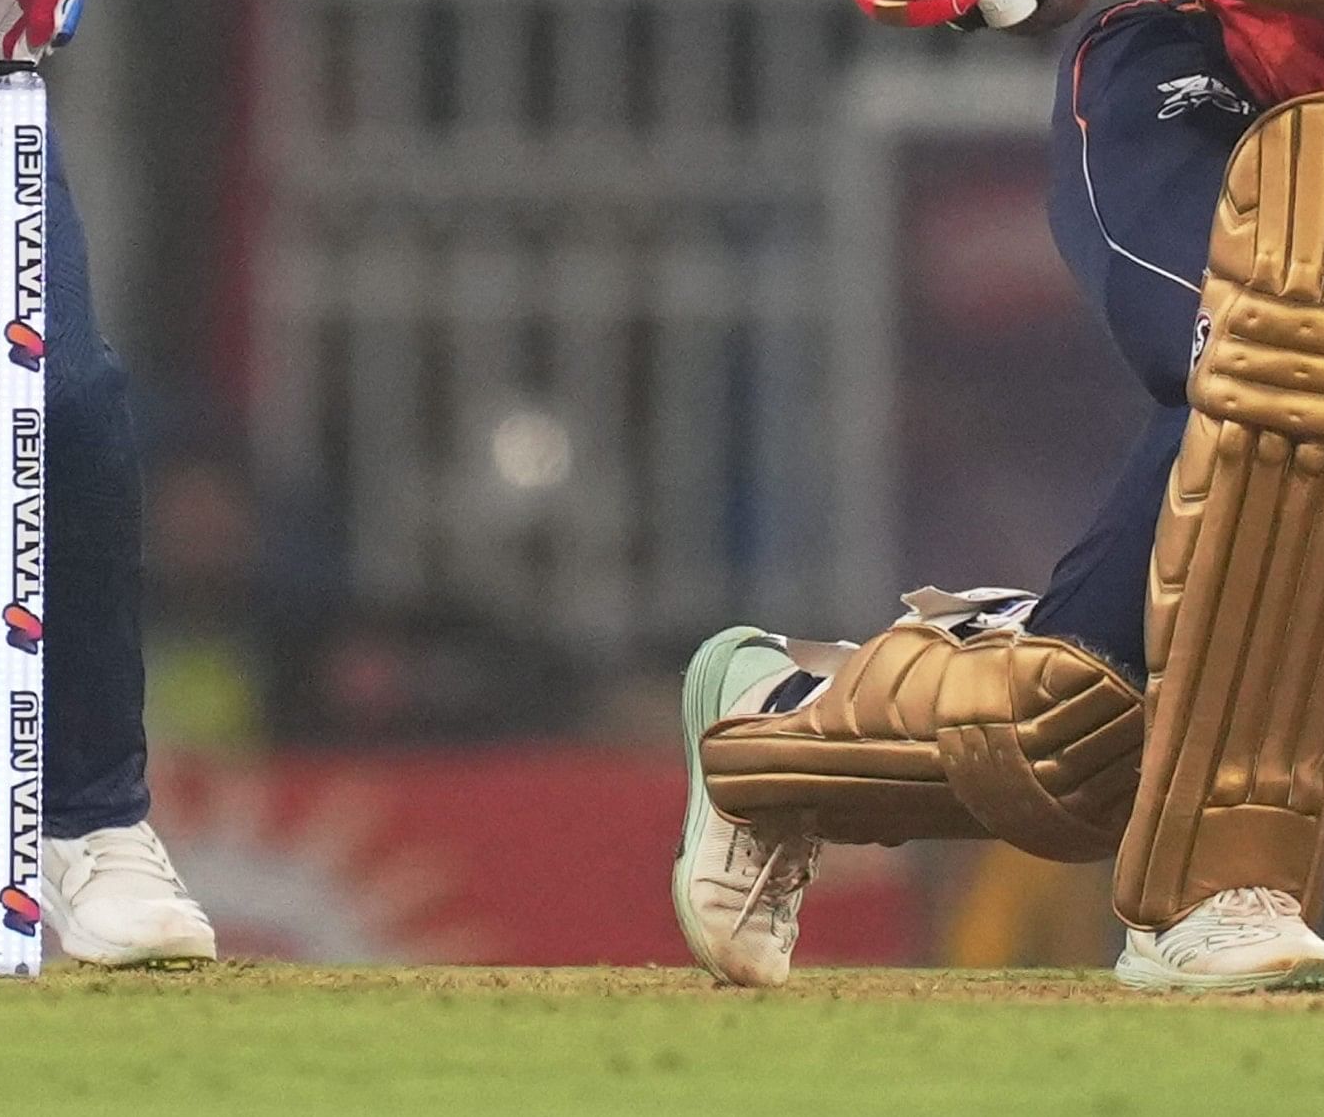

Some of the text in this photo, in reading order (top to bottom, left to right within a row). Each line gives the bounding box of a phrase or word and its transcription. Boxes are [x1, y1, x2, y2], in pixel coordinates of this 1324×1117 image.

[14, 125, 43, 320] TATA NEU
[12, 408, 41, 603] TATA NEU
[9, 690, 39, 886] TATA NEU
